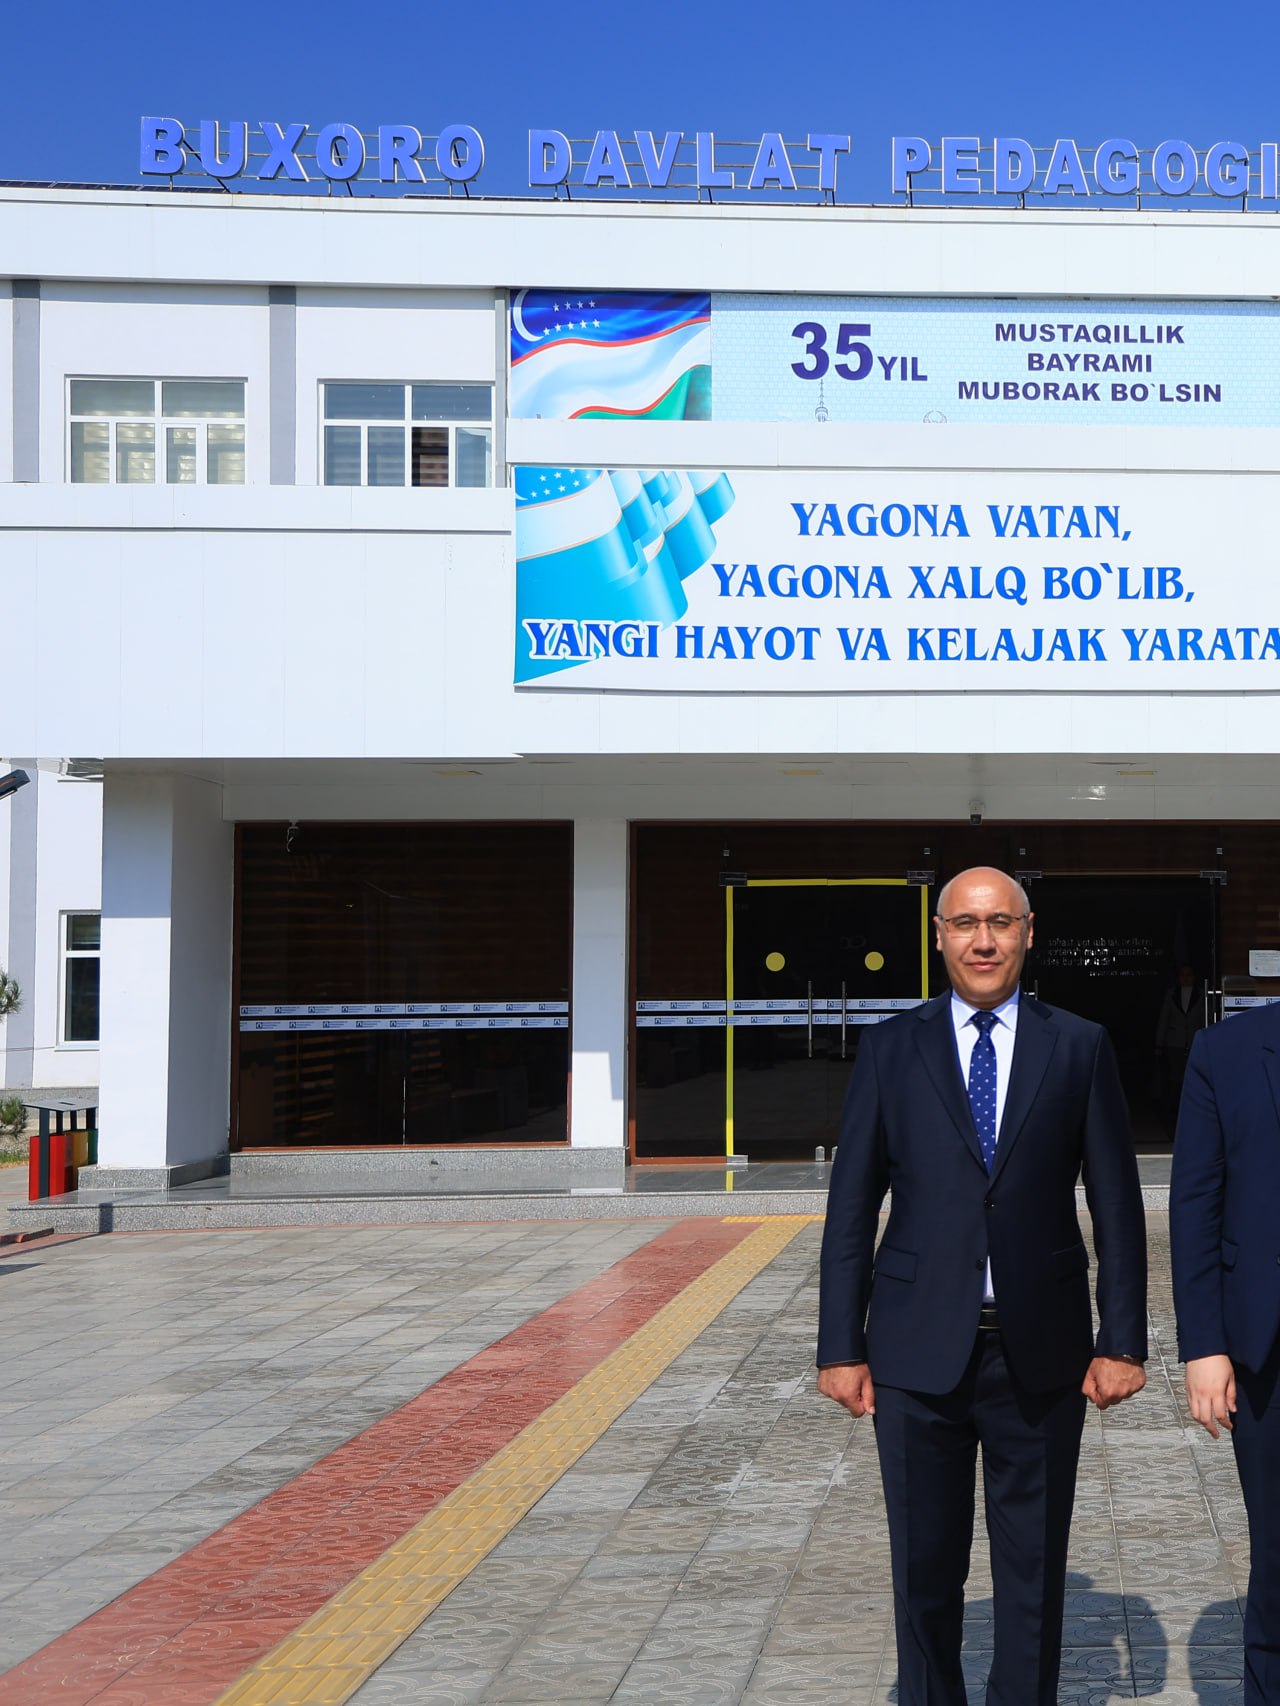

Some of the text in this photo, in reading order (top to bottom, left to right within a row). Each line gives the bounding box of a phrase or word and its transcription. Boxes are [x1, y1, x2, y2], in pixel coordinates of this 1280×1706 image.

[140, 116, 486, 184] BUXORO
[528, 129, 851, 192] DAVLAT
[790, 321, 928, 382] 35 YIL
[995, 323, 1185, 345] MUSTAQILLIK
[1027, 352, 1152, 373] BAYRAMI
[958, 381, 1101, 402] MUBORAK
[790, 502, 1132, 542] YAGONA VATAN,
[710, 563, 892, 599] YAGONA
[907, 565, 1028, 606] XALQ
[526, 622, 659, 658] YANGI
[675, 625, 822, 661] HAYOT
[836, 627, 892, 661] VA
[907, 627, 1108, 662] KELAJAK
